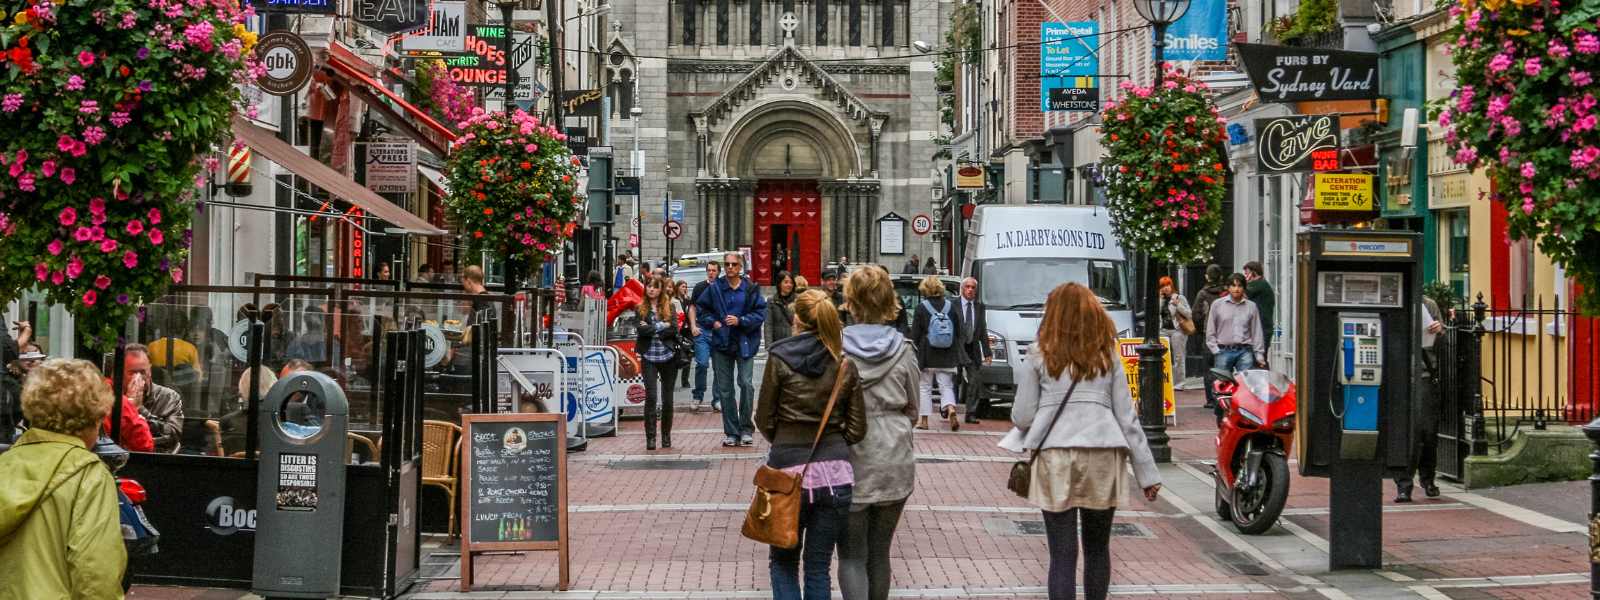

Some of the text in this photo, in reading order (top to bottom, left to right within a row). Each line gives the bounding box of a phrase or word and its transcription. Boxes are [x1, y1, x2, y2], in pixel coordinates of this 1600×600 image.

[476, 27, 506, 38] WINE
[1046, 26, 1092, 36] Prime Retail
[1164, 33, 1218, 50] Smiles
[266, 52, 294, 71] gbk
[1276, 55, 1330, 66] FURS BY
[1261, 68, 1374, 98] Sydney Vard
[1052, 100, 1096, 109] WHETSTONE
[1312, 151, 1338, 159] WINE
[1314, 160, 1338, 170] BAR
[916, 220, 926, 228] 50
[1086, 232, 1104, 250] LTD
[281, 455, 316, 464] LITTER IS
